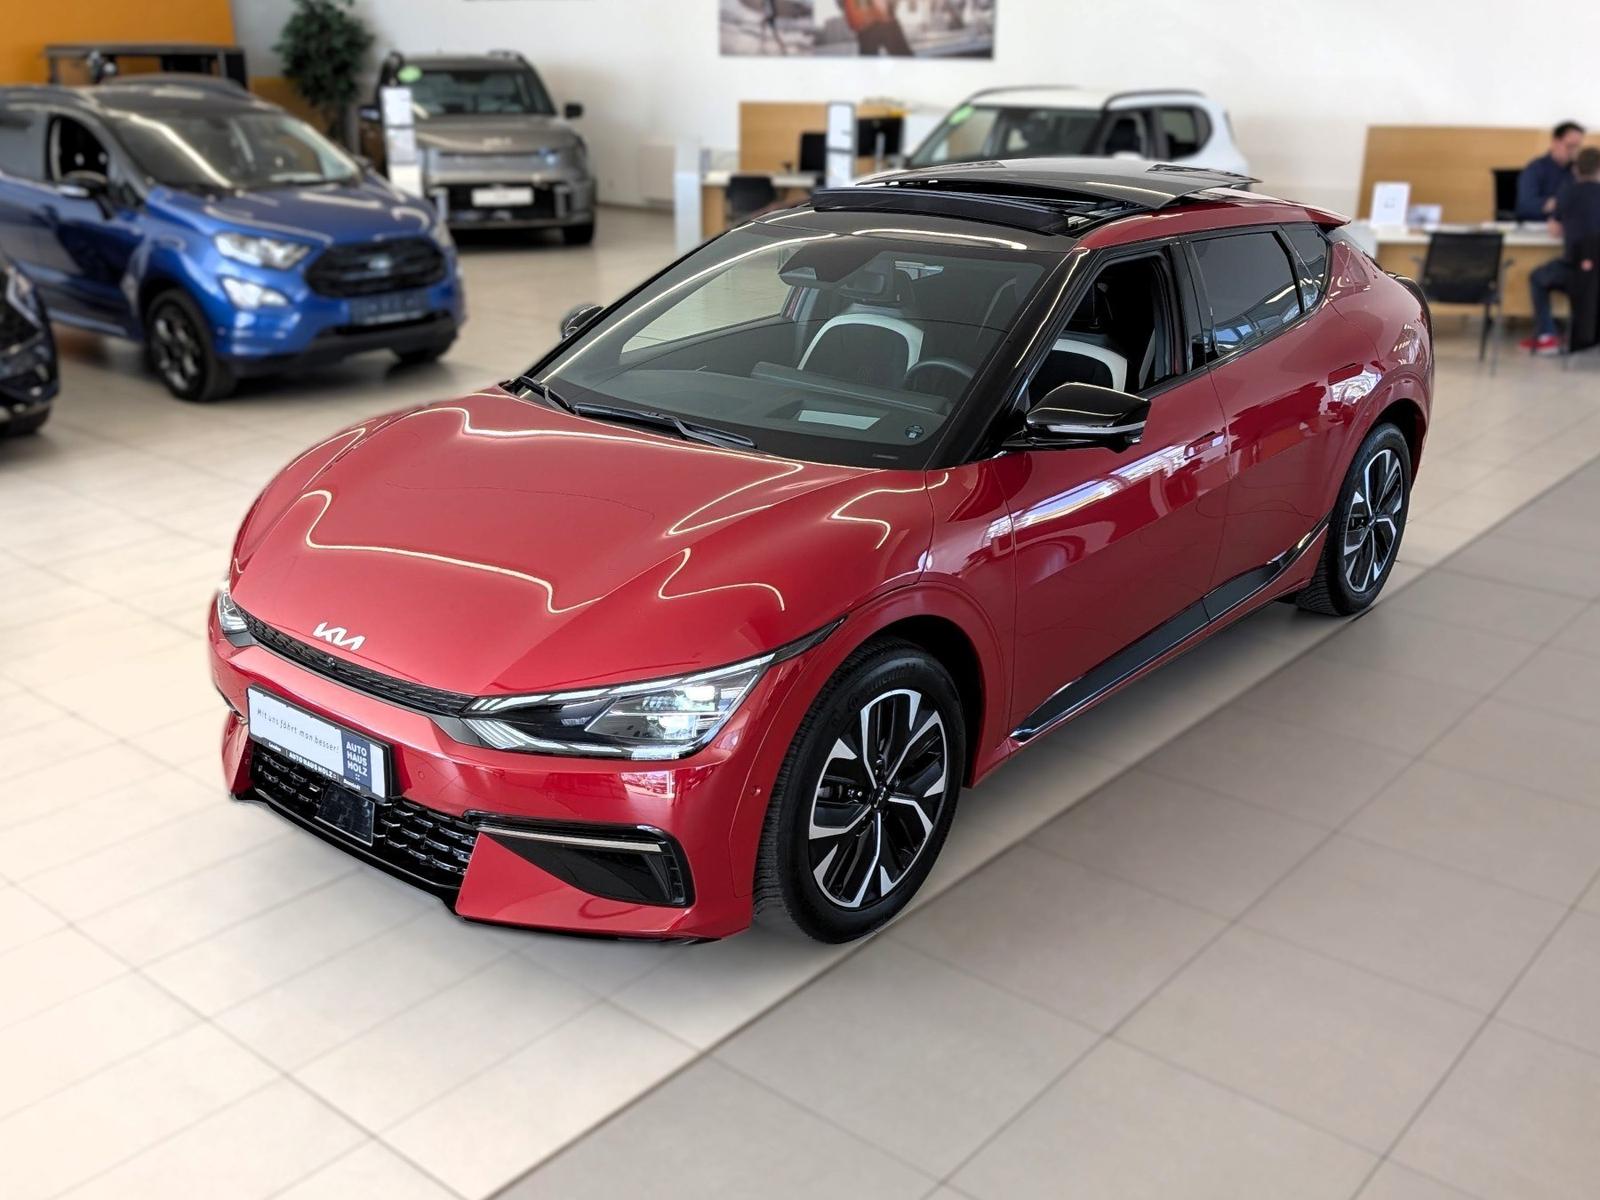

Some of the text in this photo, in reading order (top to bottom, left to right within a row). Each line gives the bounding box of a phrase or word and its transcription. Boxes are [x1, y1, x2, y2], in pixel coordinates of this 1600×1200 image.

[257, 706, 267, 720] Mit
[268, 714, 280, 726] uns
[299, 730, 313, 742] man
[346, 741, 367, 757] AUTO
[347, 750, 368, 767] HAUS
[347, 760, 368, 777] HOLZ
